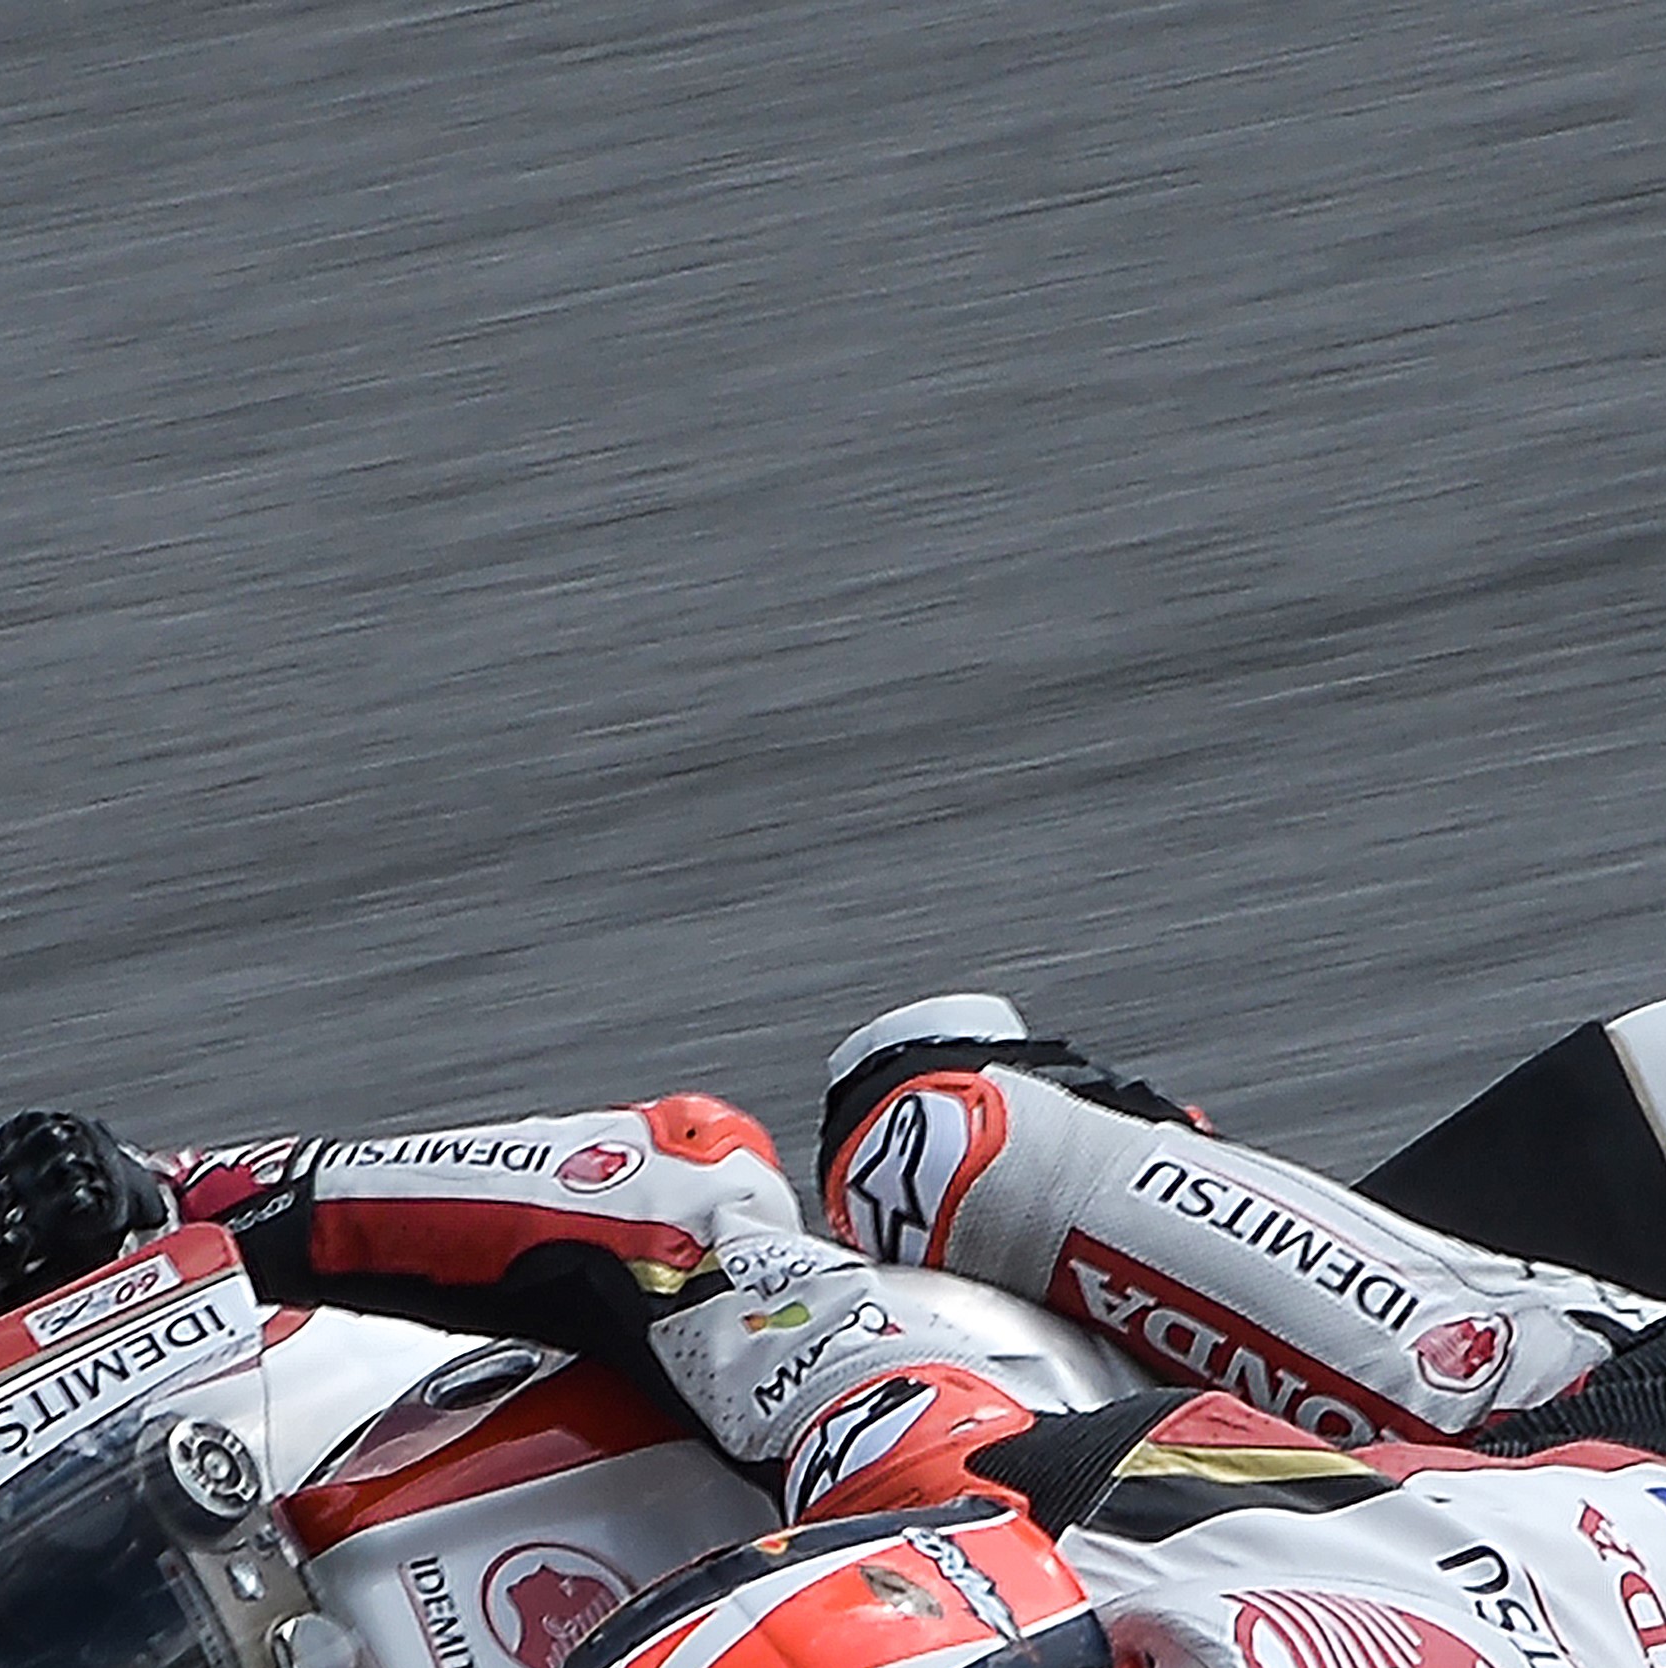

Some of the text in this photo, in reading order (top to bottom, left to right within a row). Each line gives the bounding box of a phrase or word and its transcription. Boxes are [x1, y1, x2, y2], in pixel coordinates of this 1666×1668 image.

[323, 1139, 555, 1174] IDEMITSU
[1136, 1159, 1420, 1334] IDEMITSU
[1069, 1260, 1403, 1449] ONDA
